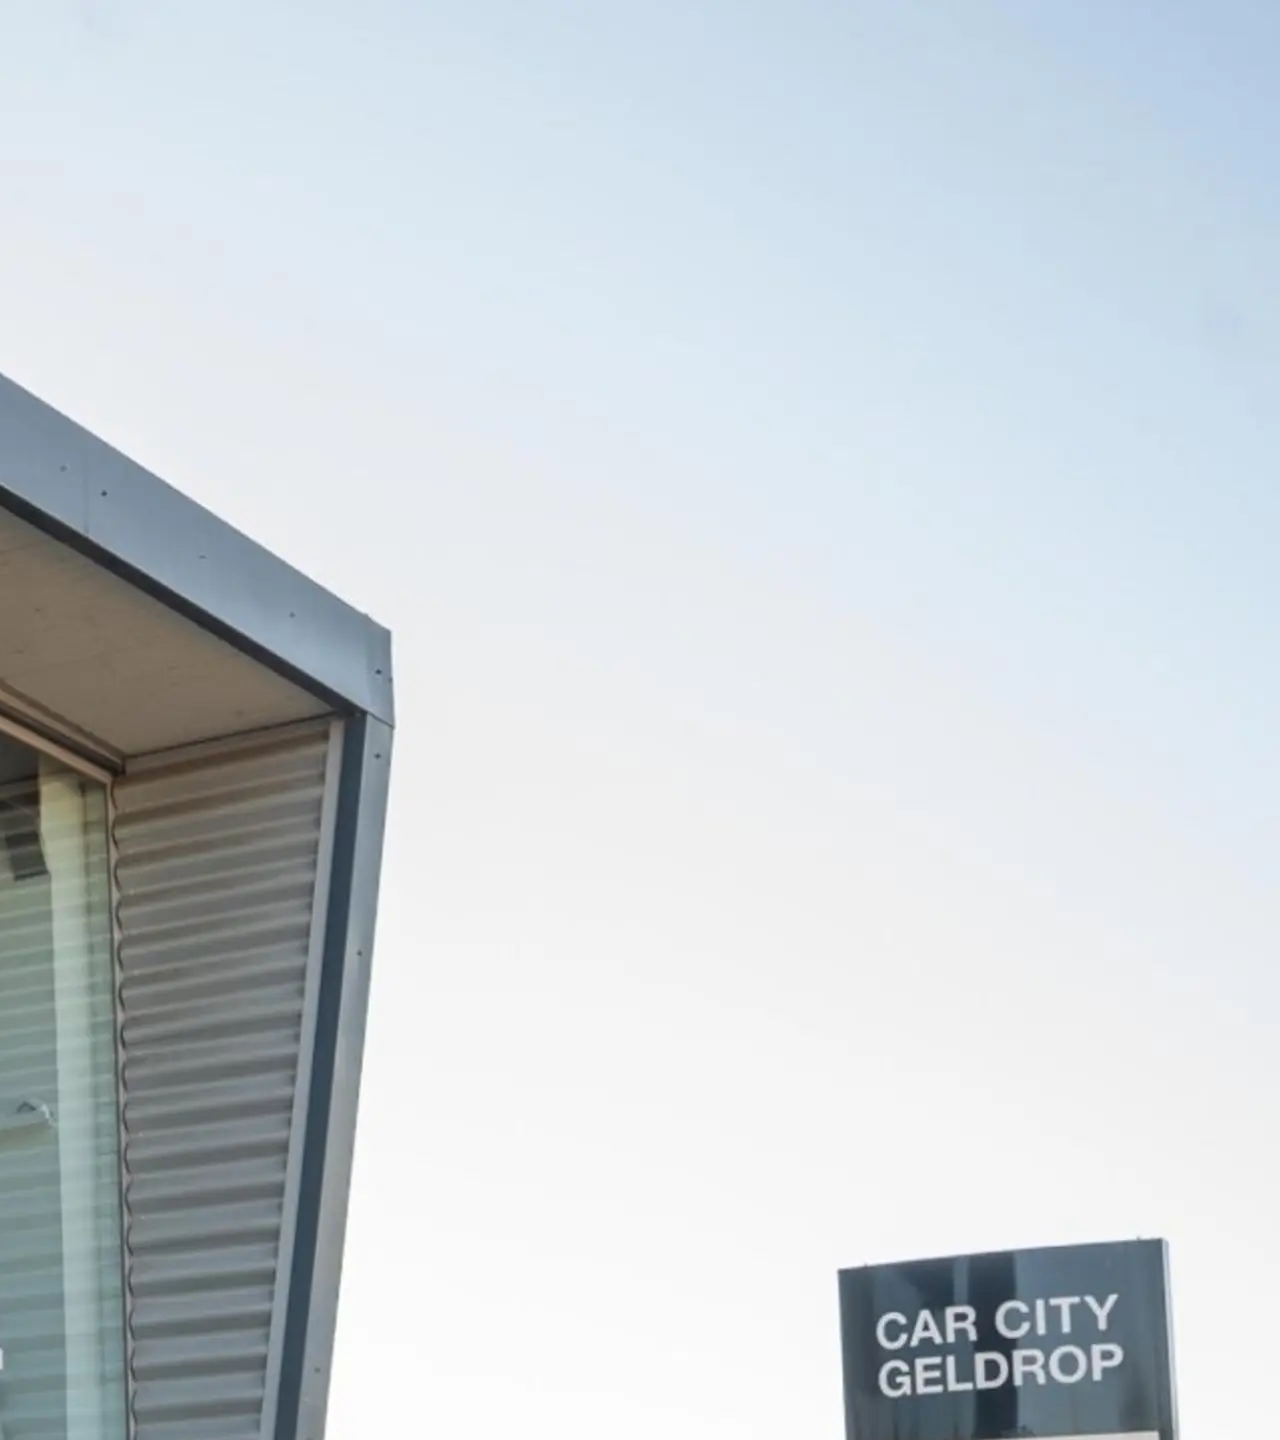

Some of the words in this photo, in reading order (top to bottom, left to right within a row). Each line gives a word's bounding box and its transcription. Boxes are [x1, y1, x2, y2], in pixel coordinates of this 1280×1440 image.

[875, 1304, 978, 1350] CAR
[995, 1293, 1119, 1339] CITY
[878, 1342, 1124, 1398] GELDROP
